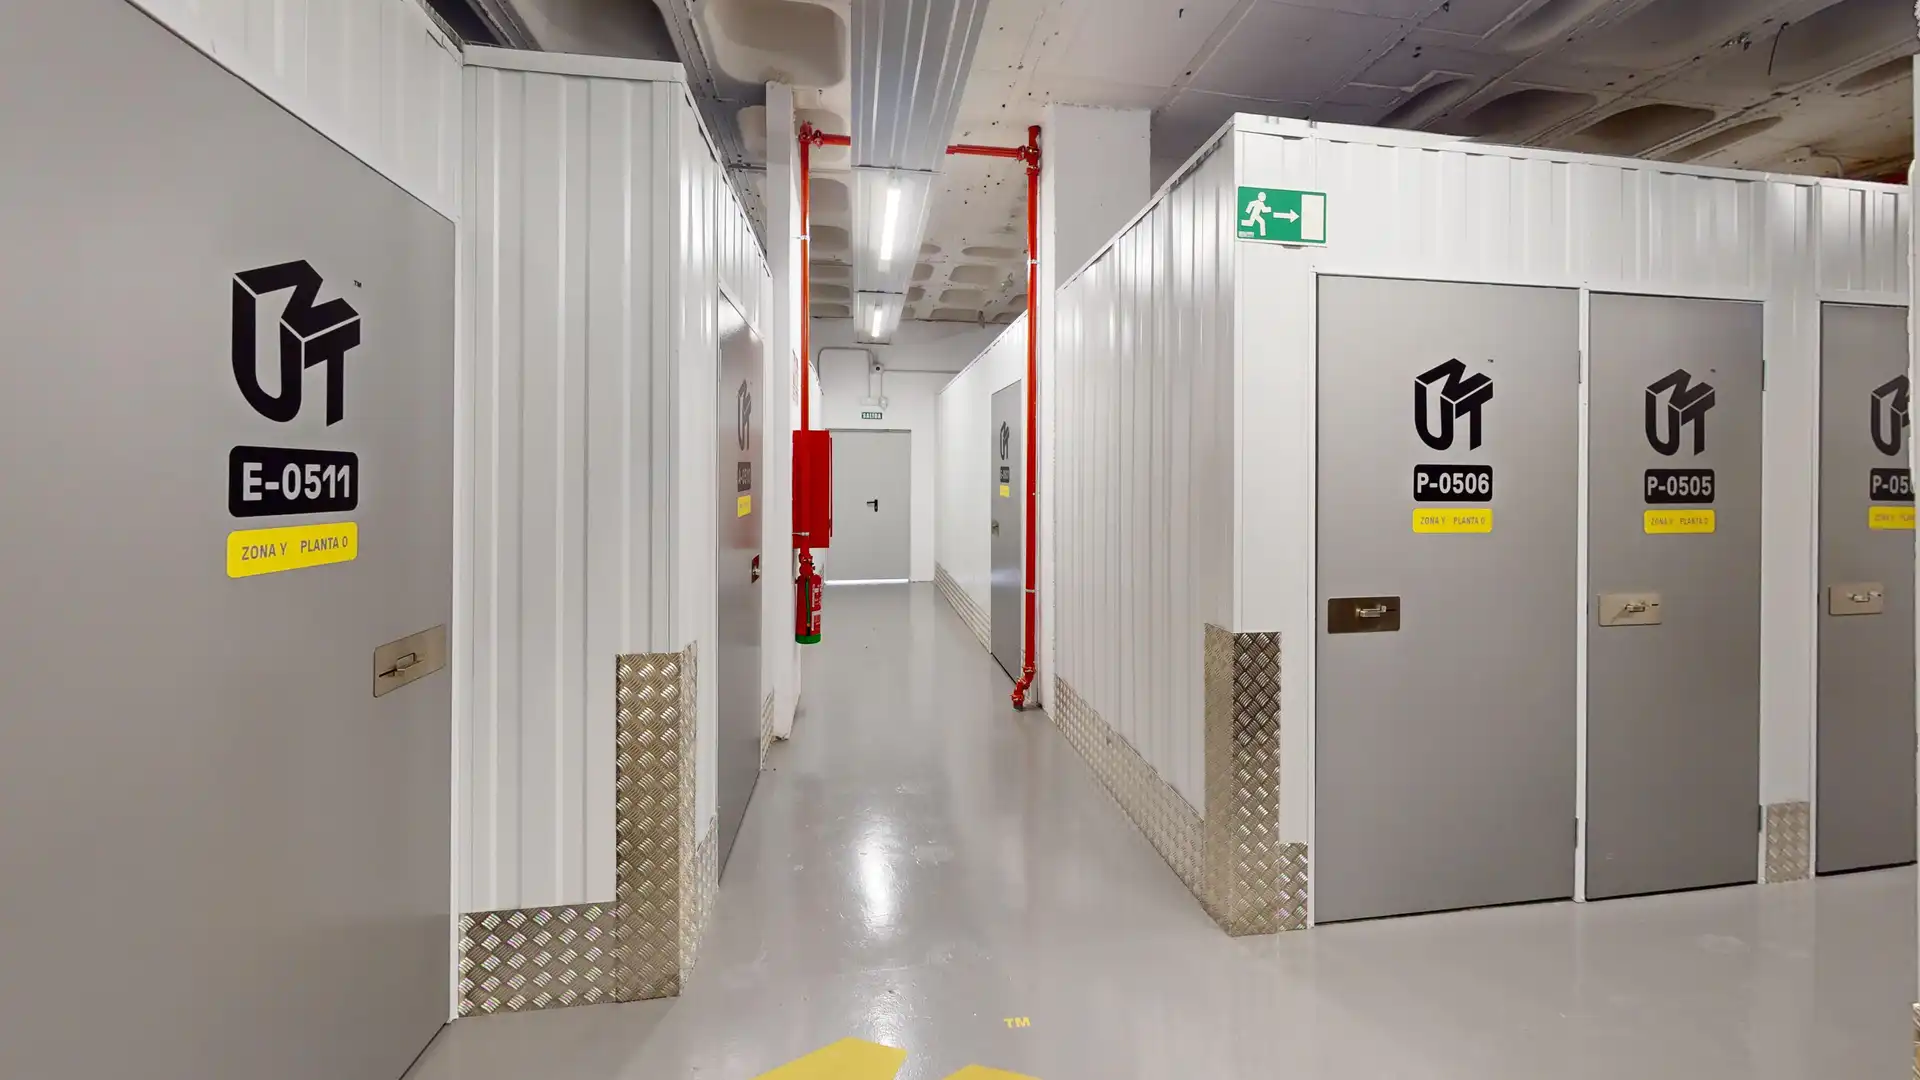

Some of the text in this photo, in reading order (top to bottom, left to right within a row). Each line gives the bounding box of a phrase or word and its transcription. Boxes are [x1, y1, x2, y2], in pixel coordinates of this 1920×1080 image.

[242, 462, 350, 502] E-0511
[1417, 472, 1490, 494] P-0506
[1647, 476, 1712, 496] P-0505
[1420, 516, 1439, 525] ZONA
[1441, 516, 1446, 525] Y
[1453, 516, 1479, 525] PLANTA
[241, 543, 276, 561] ZONA
[280, 542, 288, 555] Y
[300, 537, 339, 553] PLANTA
[1004, 1017, 1031, 1028] TM
